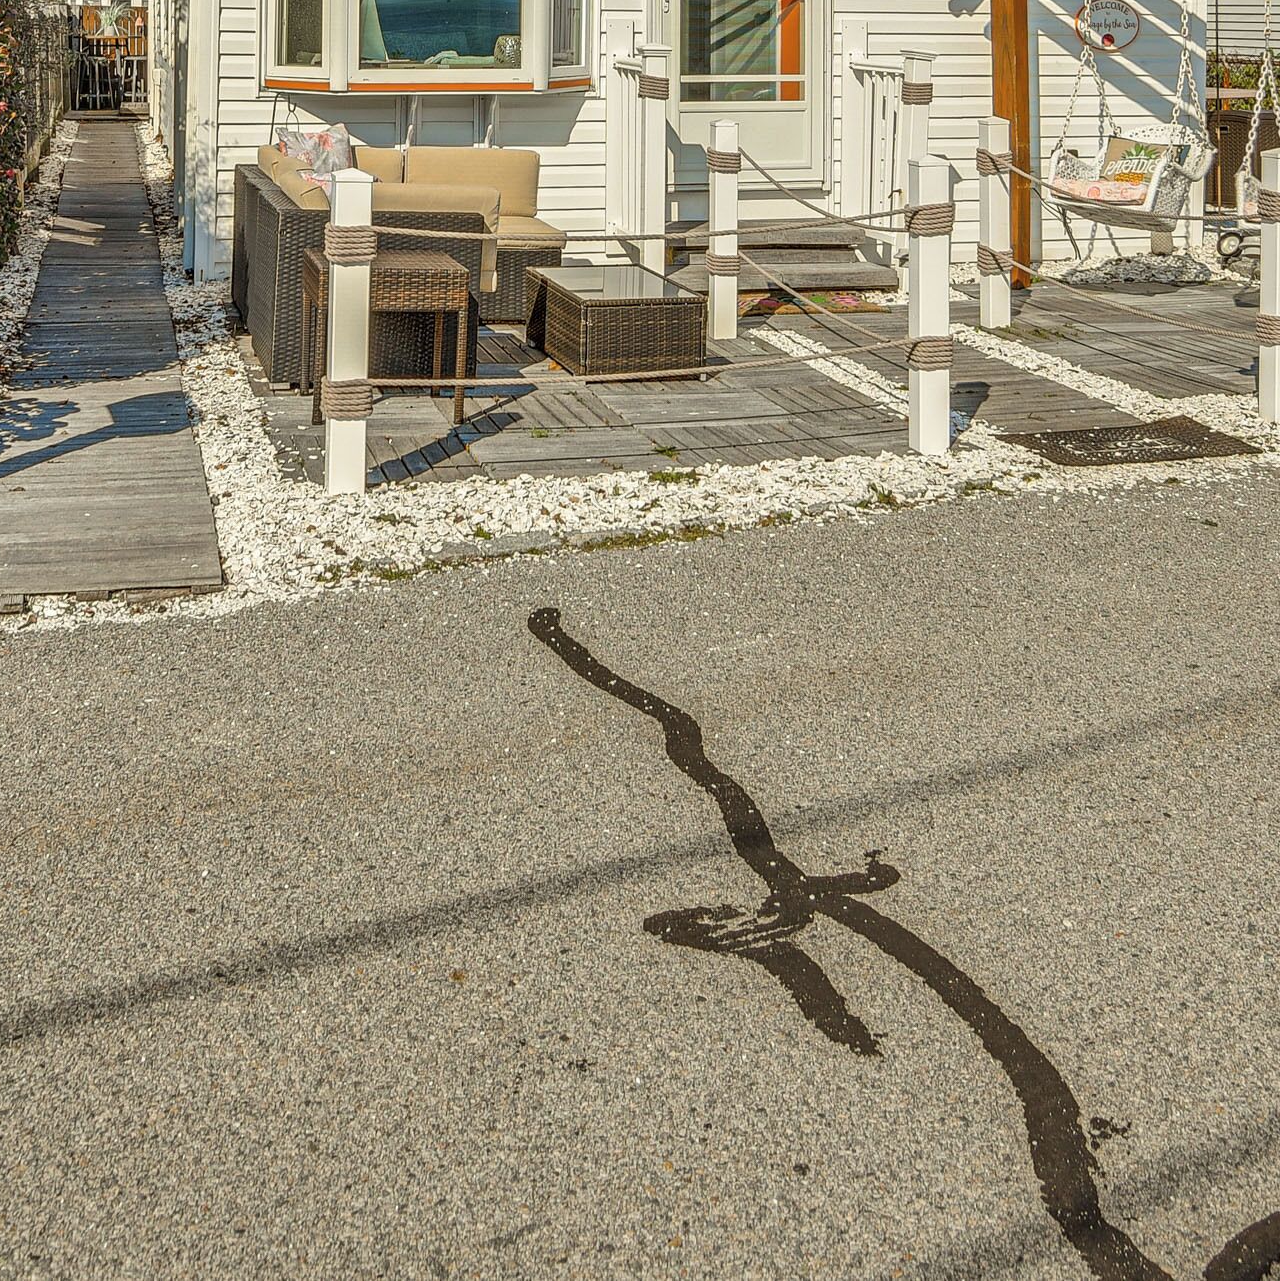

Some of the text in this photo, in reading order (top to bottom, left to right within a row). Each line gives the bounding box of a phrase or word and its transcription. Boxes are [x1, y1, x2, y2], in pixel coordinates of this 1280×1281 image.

[1104, 18, 1111, 32] by
[1112, 19, 1121, 29] the
[1124, 19, 1136, 29] Sea
[1104, 159, 1161, 175] PARADIS
